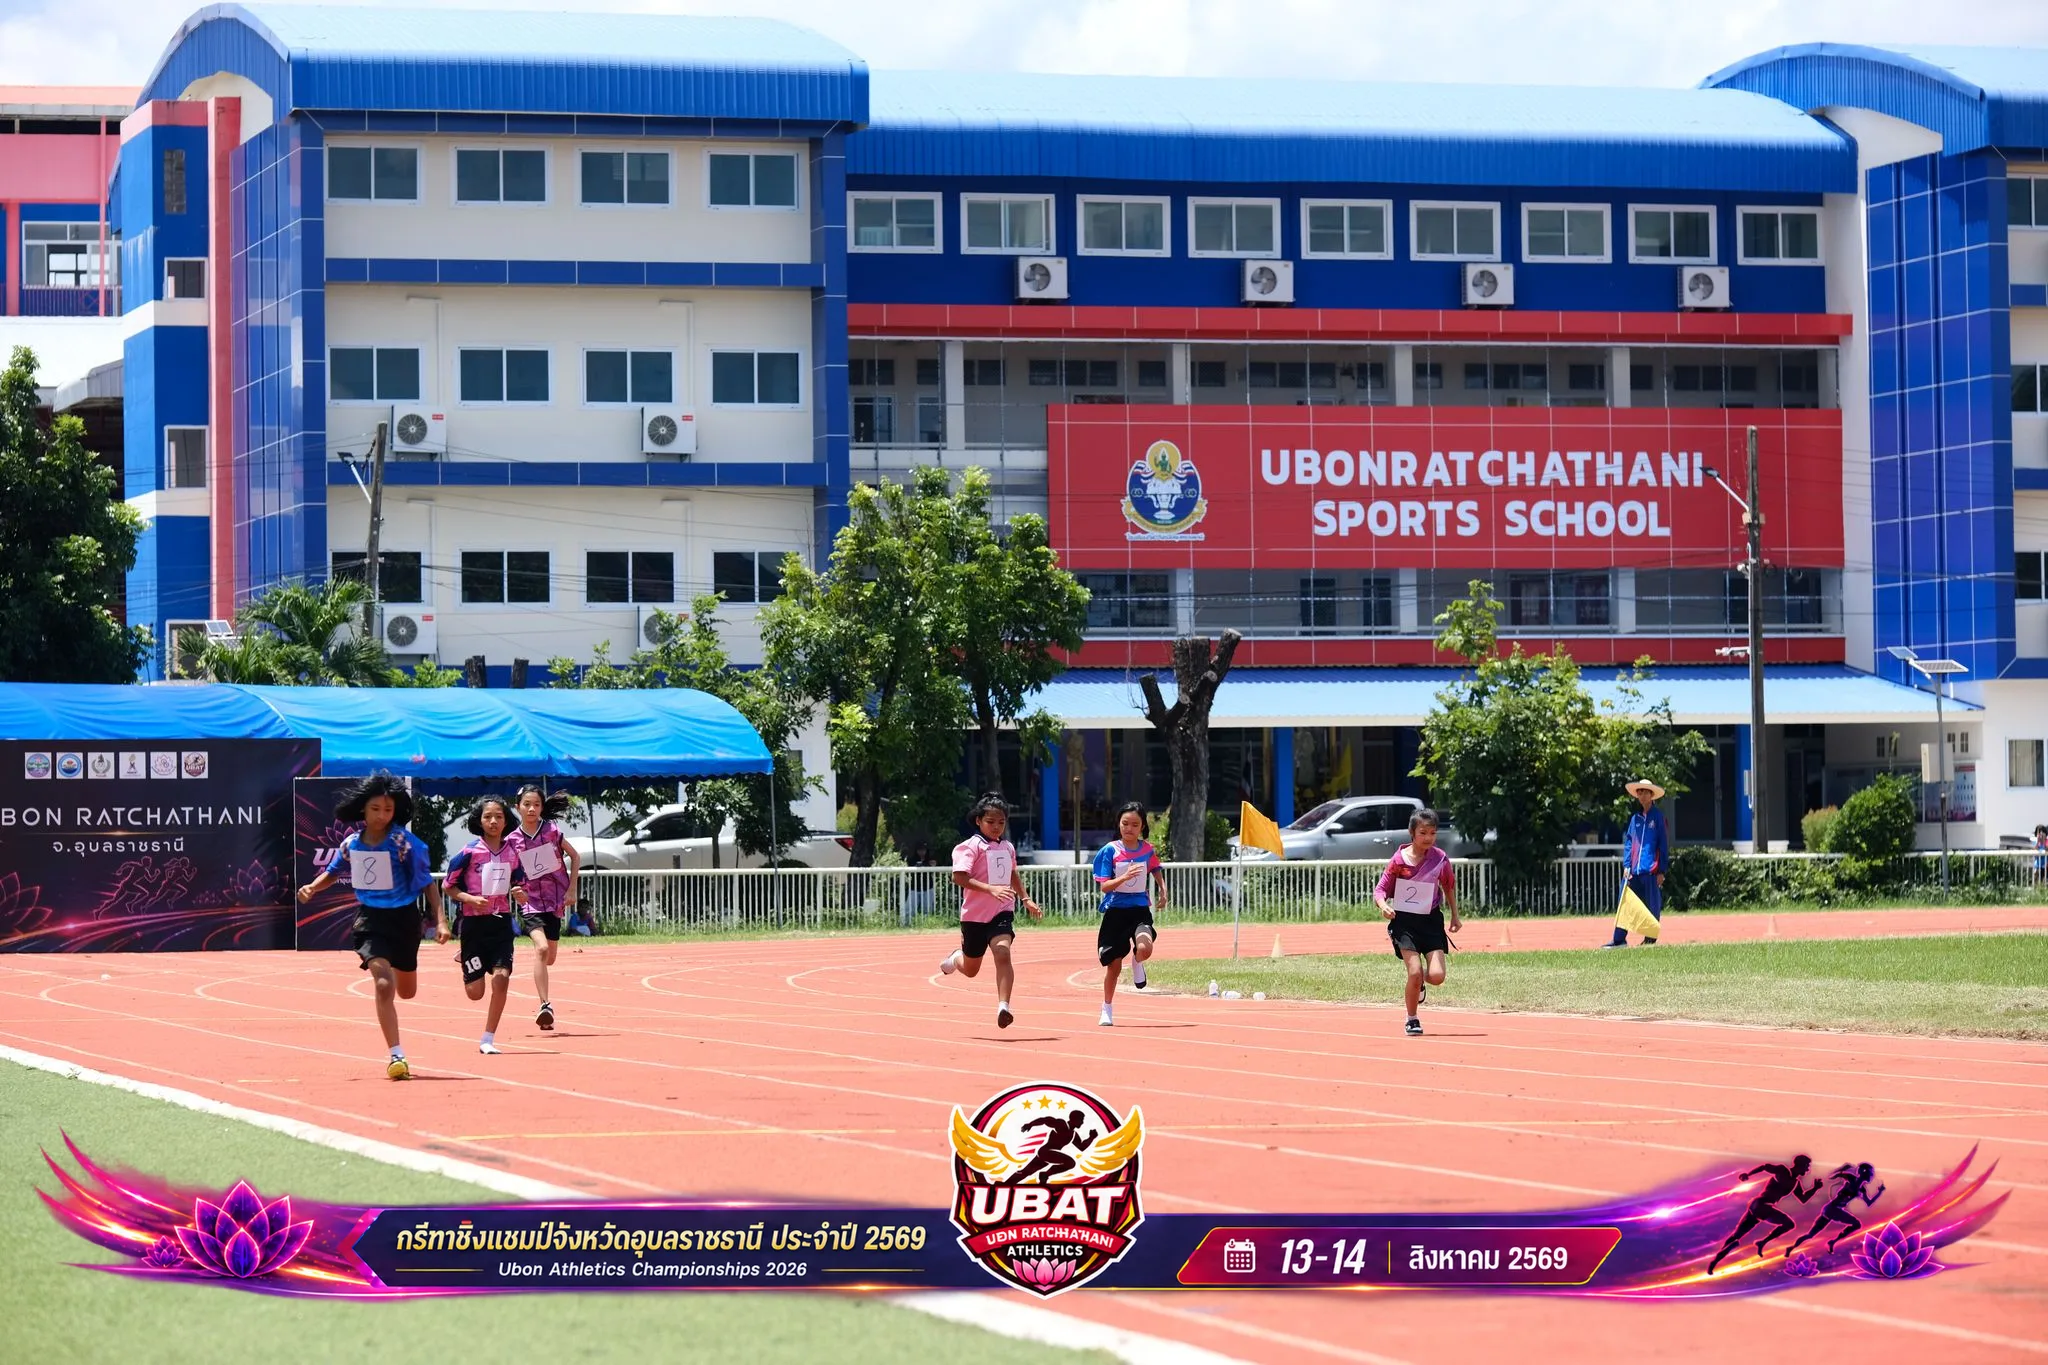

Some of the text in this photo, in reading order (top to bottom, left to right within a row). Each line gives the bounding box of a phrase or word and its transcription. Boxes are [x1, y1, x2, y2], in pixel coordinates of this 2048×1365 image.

[1261, 450, 1704, 487] UBONRATCHATHANI
[1313, 500, 1671, 537] SPORTS SCHOOL
[76, 805, 262, 826] RATCHATHANI
[52, 837, 184, 858] จ.อุบลราชธานี
[363, 857, 377, 885] 8
[533, 852, 545, 871] 6
[996, 856, 1006, 880] 5
[491, 868, 506, 887] 7
[1404, 886, 1420, 905] 2
